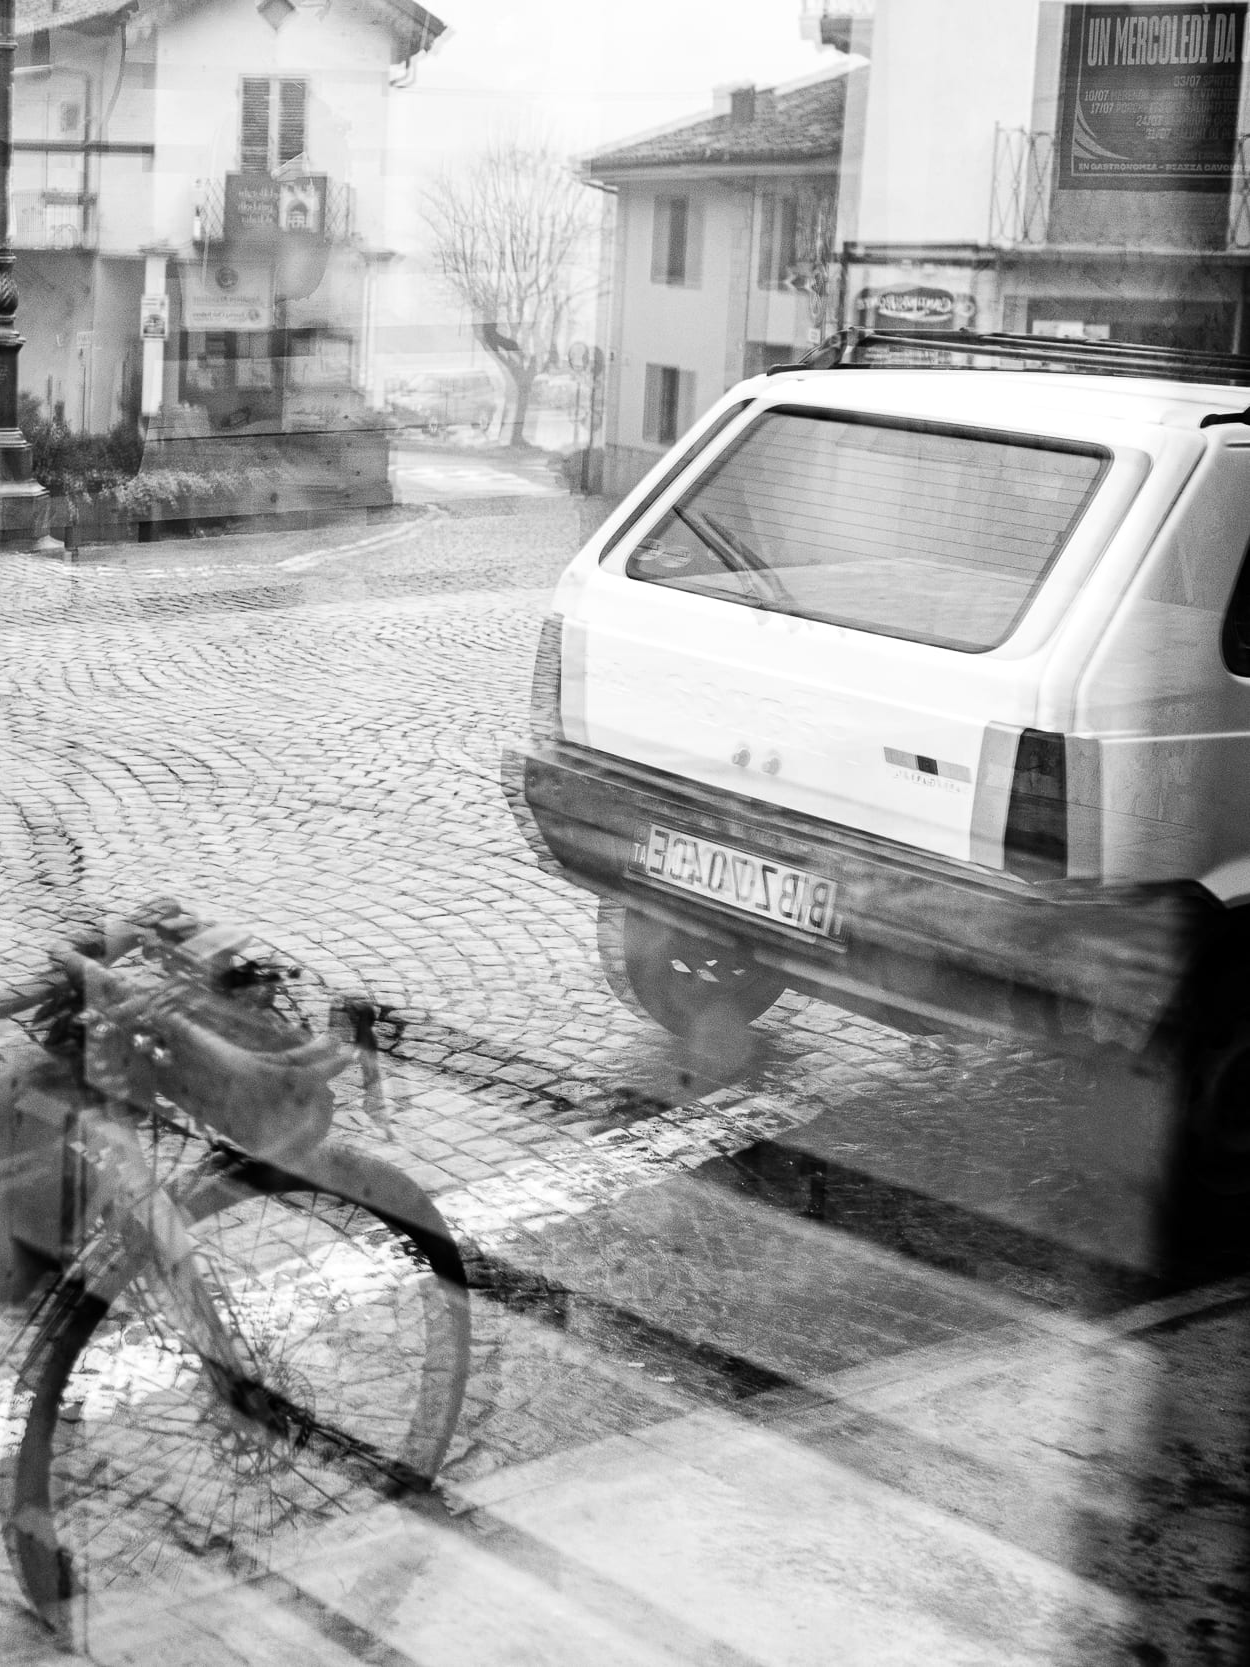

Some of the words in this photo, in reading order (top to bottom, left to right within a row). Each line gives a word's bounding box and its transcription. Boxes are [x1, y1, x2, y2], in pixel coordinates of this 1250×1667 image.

[1087, 18, 1111, 66] UN
[1114, 4, 1211, 65] MERCOLEDÌ
[1213, 13, 1236, 64] DA
[1173, 75, 1201, 87] 03/07
[1084, 89, 1110, 102] 10/07
[1090, 102, 1115, 114] 17/07
[1165, 163, 1202, 172] PIAZZA
